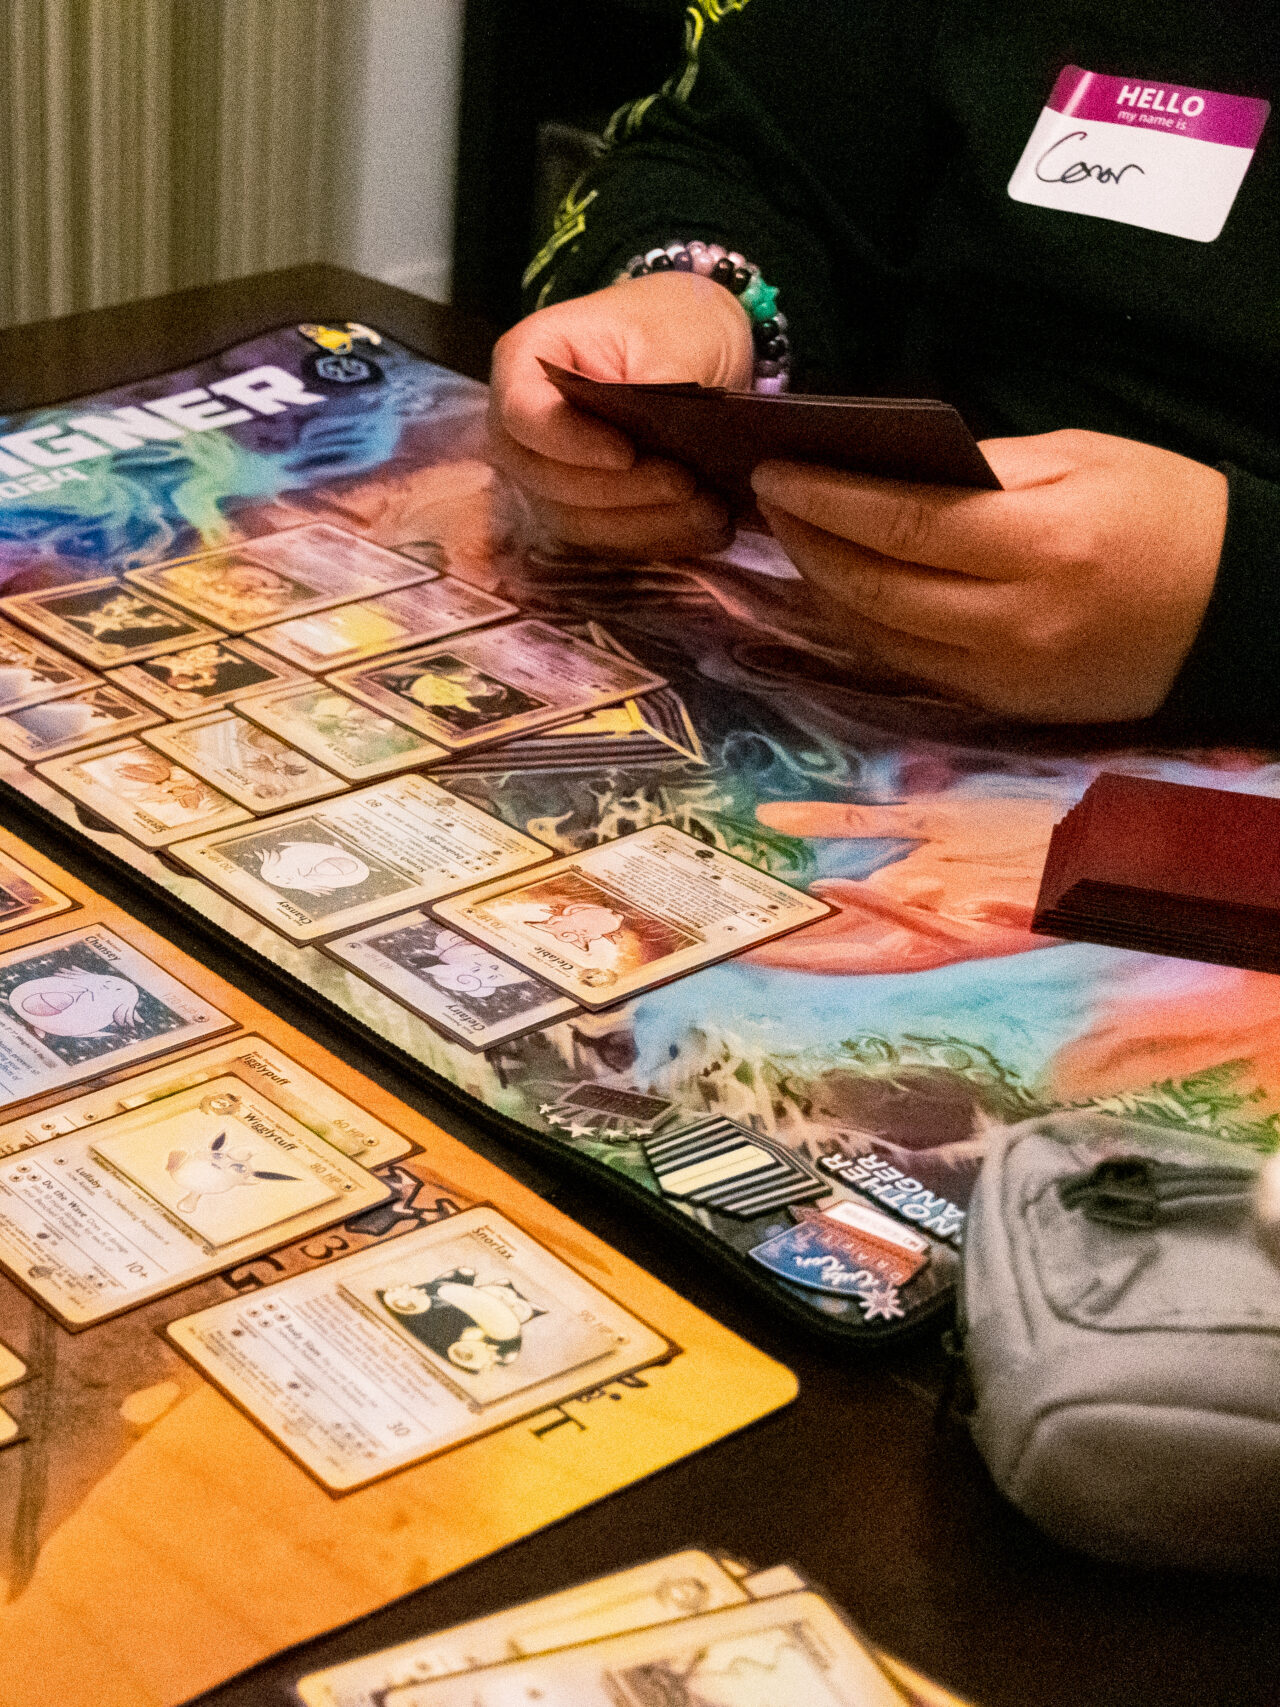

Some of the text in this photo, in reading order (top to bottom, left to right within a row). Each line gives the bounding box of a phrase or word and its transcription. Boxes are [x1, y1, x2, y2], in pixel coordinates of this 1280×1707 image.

[1116, 84, 1205, 117] HELLO
[1117, 110, 1188, 130] my name is
[364, 798, 383, 808] 80
[206, 855, 313, 924] Chansey 120 HP
[81, 935, 121, 961] Chansey
[533, 946, 574, 970] Clefable
[445, 1002, 486, 1032] Clefairy
[238, 1051, 365, 1142] Jigglypuff 60 HP
[242, 1112, 342, 1183] Wigglytuff 80 HP
[74, 1166, 102, 1188] Lullaby
[821, 1153, 963, 1243] NOTHER
[41, 1179, 55, 1190] Do
[52, 1189, 68, 1201] the
[67, 1200, 88, 1217] Wave
[124, 1260, 149, 1278] 10+
[470, 1226, 513, 1259] Snorlax
[386, 1420, 411, 1437] 30
